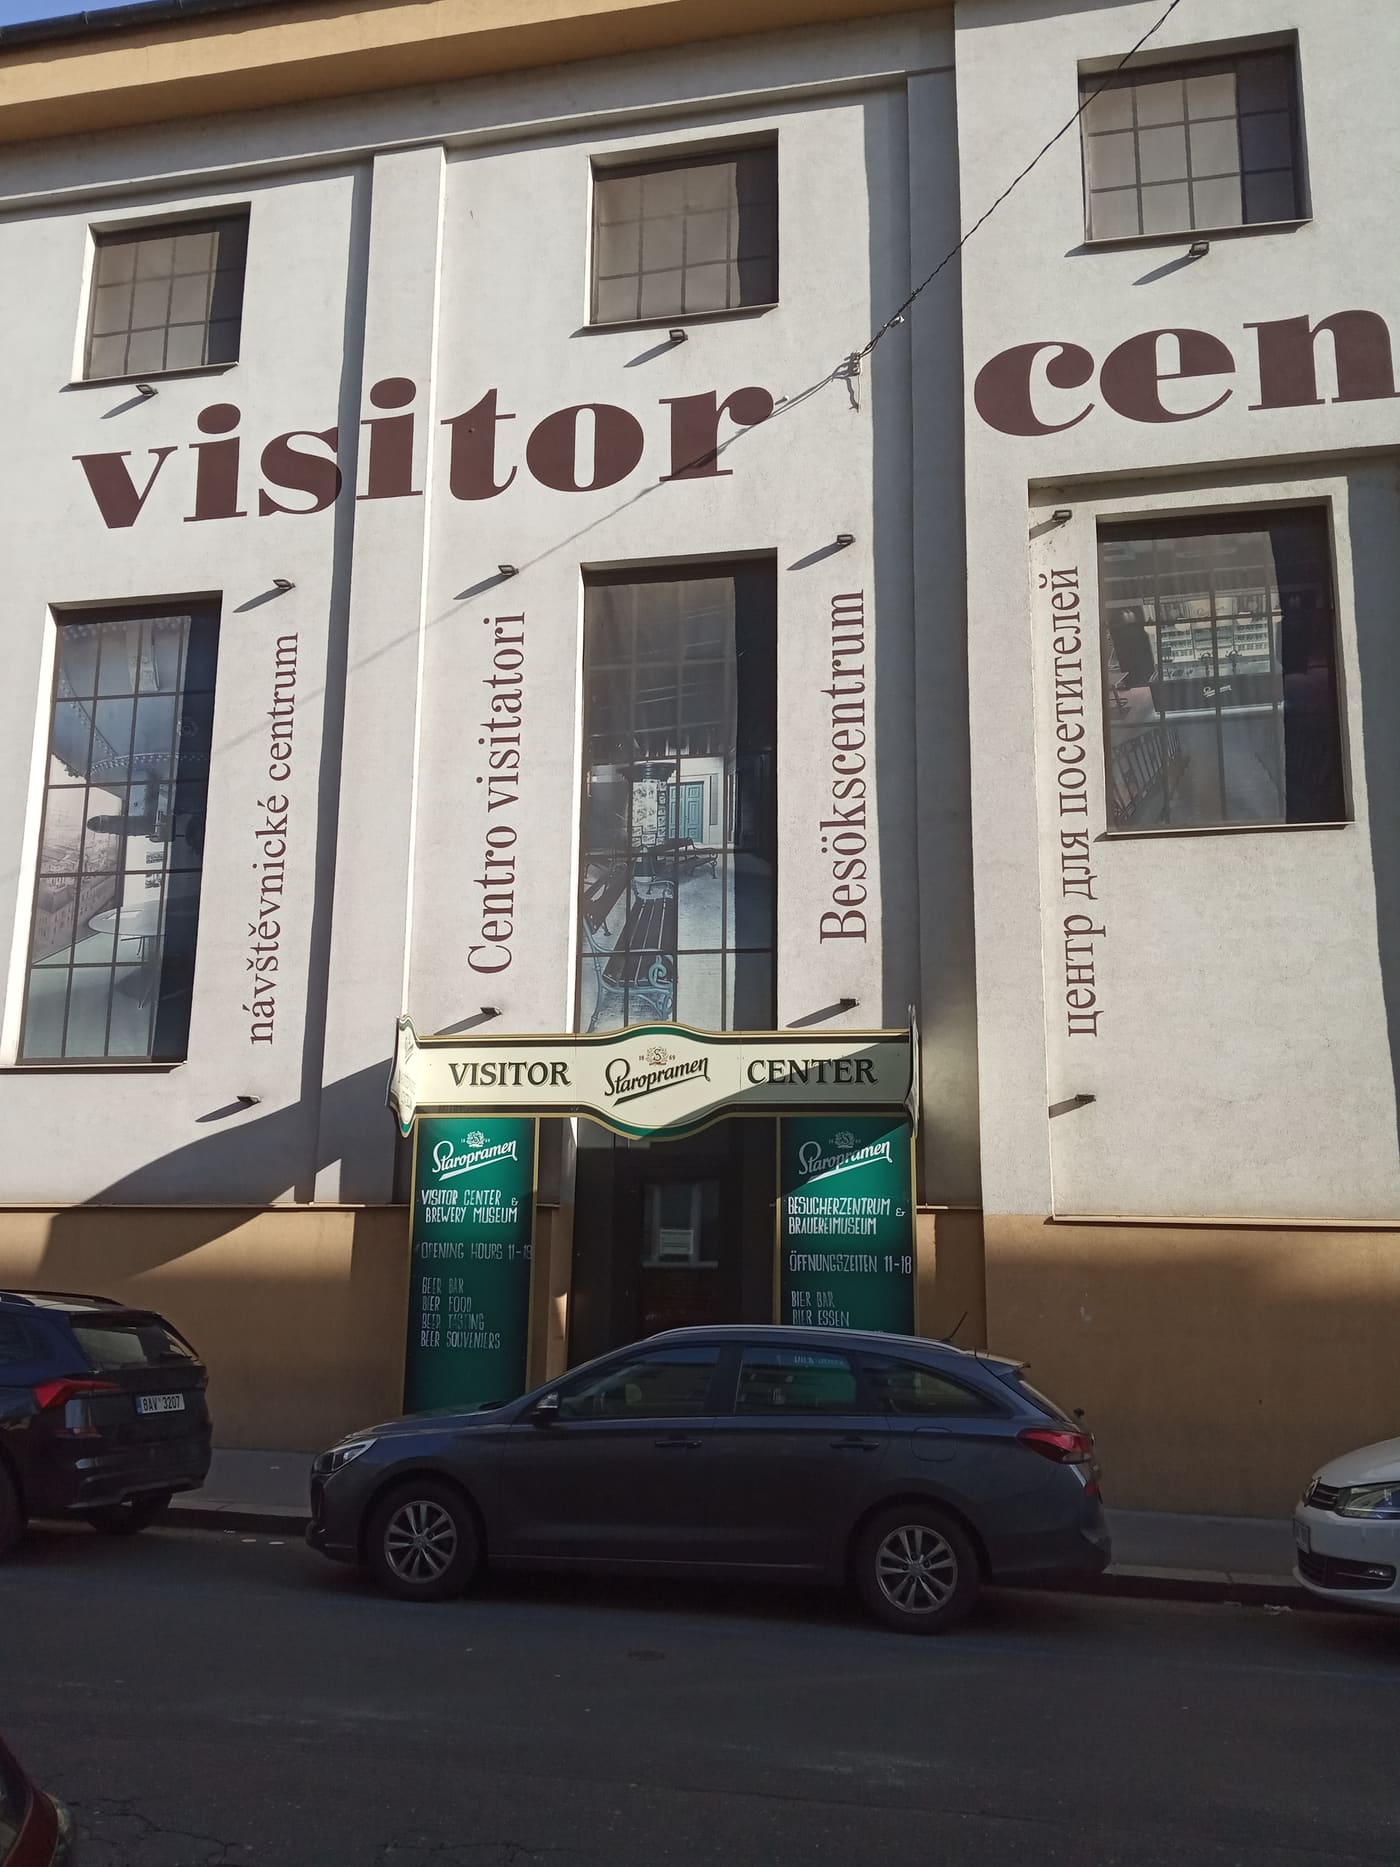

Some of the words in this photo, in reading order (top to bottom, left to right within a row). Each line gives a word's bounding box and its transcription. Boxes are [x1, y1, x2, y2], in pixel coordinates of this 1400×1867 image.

[72, 377, 774, 529] visitor
[974, 309, 1400, 436] cen
[265, 632, 299, 781] centrum
[1038, 566, 1088, 817] посетителей
[476, 611, 525, 813] visitatori
[820, 588, 868, 944] Besökscentrum
[1059, 828, 1098, 900] для
[467, 825, 518, 974] Centro
[243, 794, 289, 1045] návštěvnické
[1063, 912, 1106, 1037] центр
[448, 1061, 572, 1087] VISITOR
[604, 1057, 711, 1102] Staropramen
[747, 1058, 879, 1084] CENTER
[432, 1140, 518, 1176] Staropramen
[798, 1140, 893, 1178] Staropramen
[421, 1189, 459, 1205] VISITOR
[463, 1189, 502, 1206] CENTER
[511, 1196, 519, 1206] &
[425, 1207, 466, 1224] BREWERY
[473, 1207, 518, 1224] MUSEUM
[788, 1196, 891, 1216] BESUCHERZENTRUM
[895, 1207, 906, 1217] &
[788, 1216, 877, 1236] BRAUEREIMUSEUM
[421, 1241, 465, 1260] OPENING
[471, 1242, 503, 1260] HOURS
[789, 1249, 878, 1273] ÖFFNUNGSZEITEN
[884, 1255, 912, 1274] 11-18
[448, 1296, 472, 1313] FOOD
[791, 1290, 812, 1308] BIER
[816, 1291, 835, 1308] BAR
[818, 1309, 850, 1328] ESSEN
[420, 1330, 440, 1348] BEER
[162, 1395, 180, 1410] 3207
